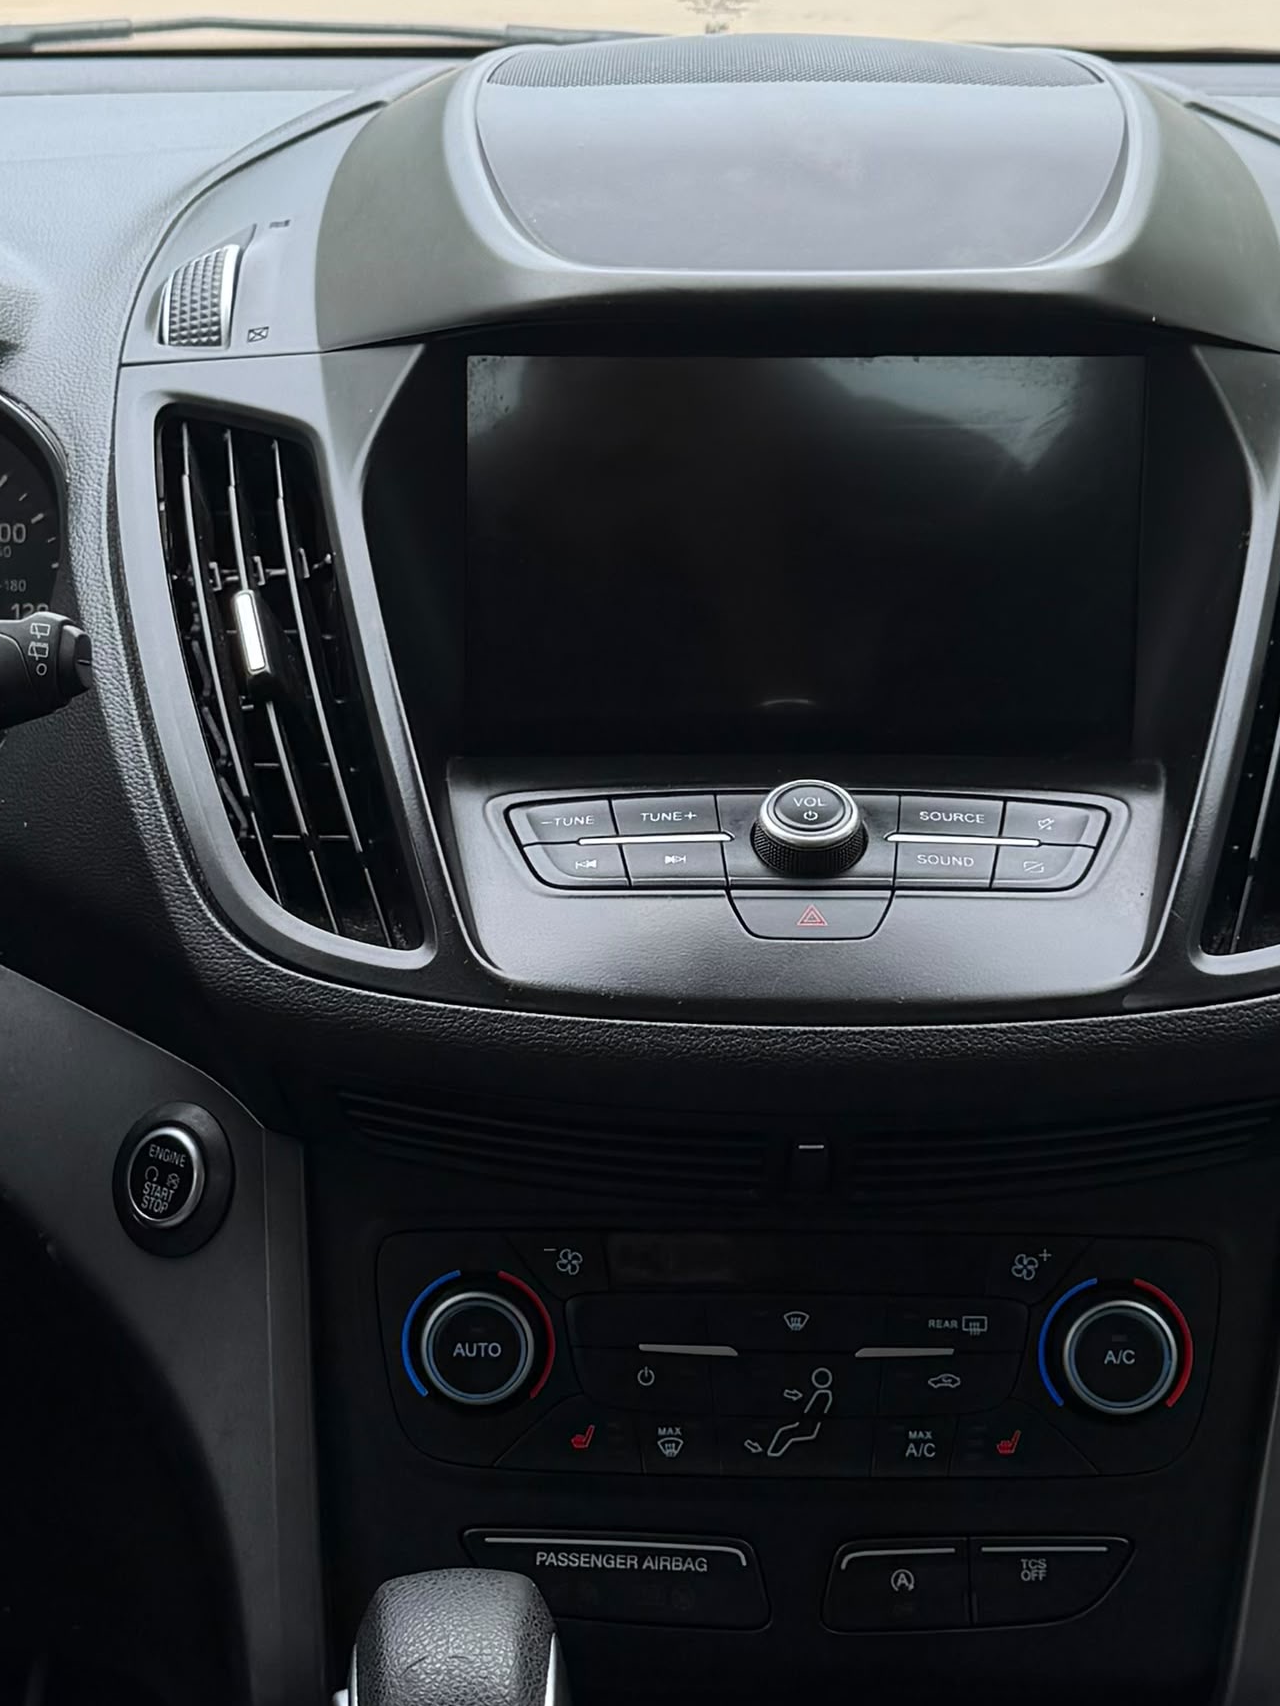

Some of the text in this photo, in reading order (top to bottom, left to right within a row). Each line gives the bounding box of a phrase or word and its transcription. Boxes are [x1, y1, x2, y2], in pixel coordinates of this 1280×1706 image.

[4, 579, 27, 592] 180
[793, 797, 826, 808] VOL
[919, 810, 985, 824] SOURCE
[916, 853, 975, 868] SOUND
[149, 1144, 187, 1168] ENGINE
[142, 1181, 175, 1203] START
[140, 1195, 169, 1214] STOP
[928, 1318, 959, 1330] REAR
[453, 1342, 502, 1359] AUTO
[1103, 1349, 1136, 1366] A/C
[657, 1426, 682, 1436] MAX
[908, 1430, 933, 1440] MAX
[905, 1442, 936, 1458] A/C
[535, 1550, 709, 1573] PASSENGER AIRBAG
[1020, 1558, 1048, 1571] TCS
[1020, 1569, 1048, 1582] OFF
